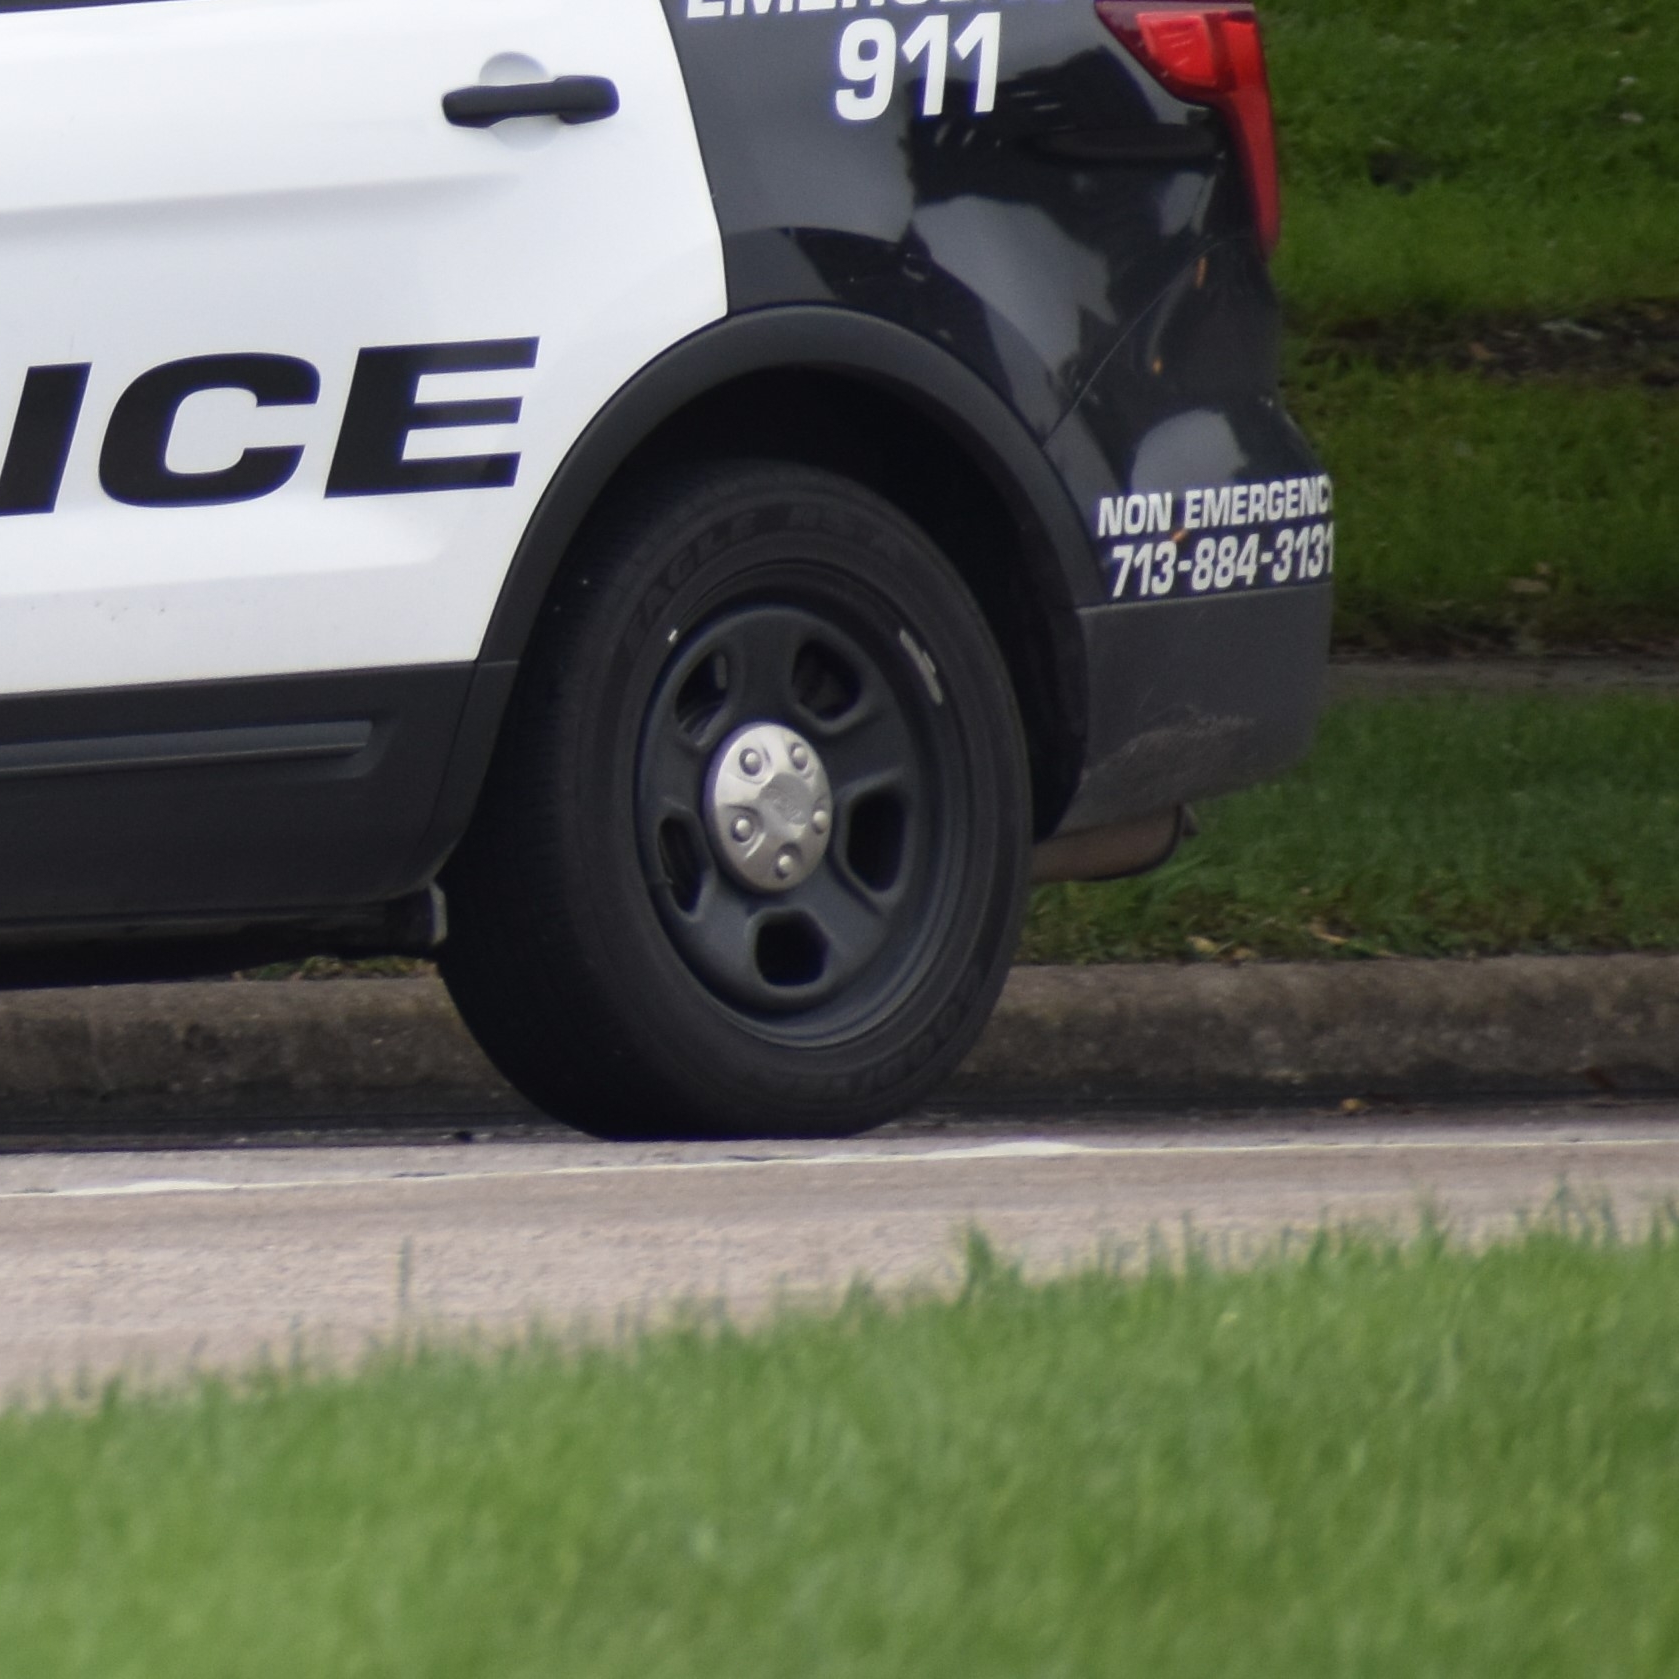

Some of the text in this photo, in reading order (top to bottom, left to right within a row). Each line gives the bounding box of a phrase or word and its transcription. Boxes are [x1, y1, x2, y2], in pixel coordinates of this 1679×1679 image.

[835, 12, 1002, 122] 911
[1097, 473, 1334, 538] NON EMERGENC
[1111, 520, 1335, 599] 713-884-3131
